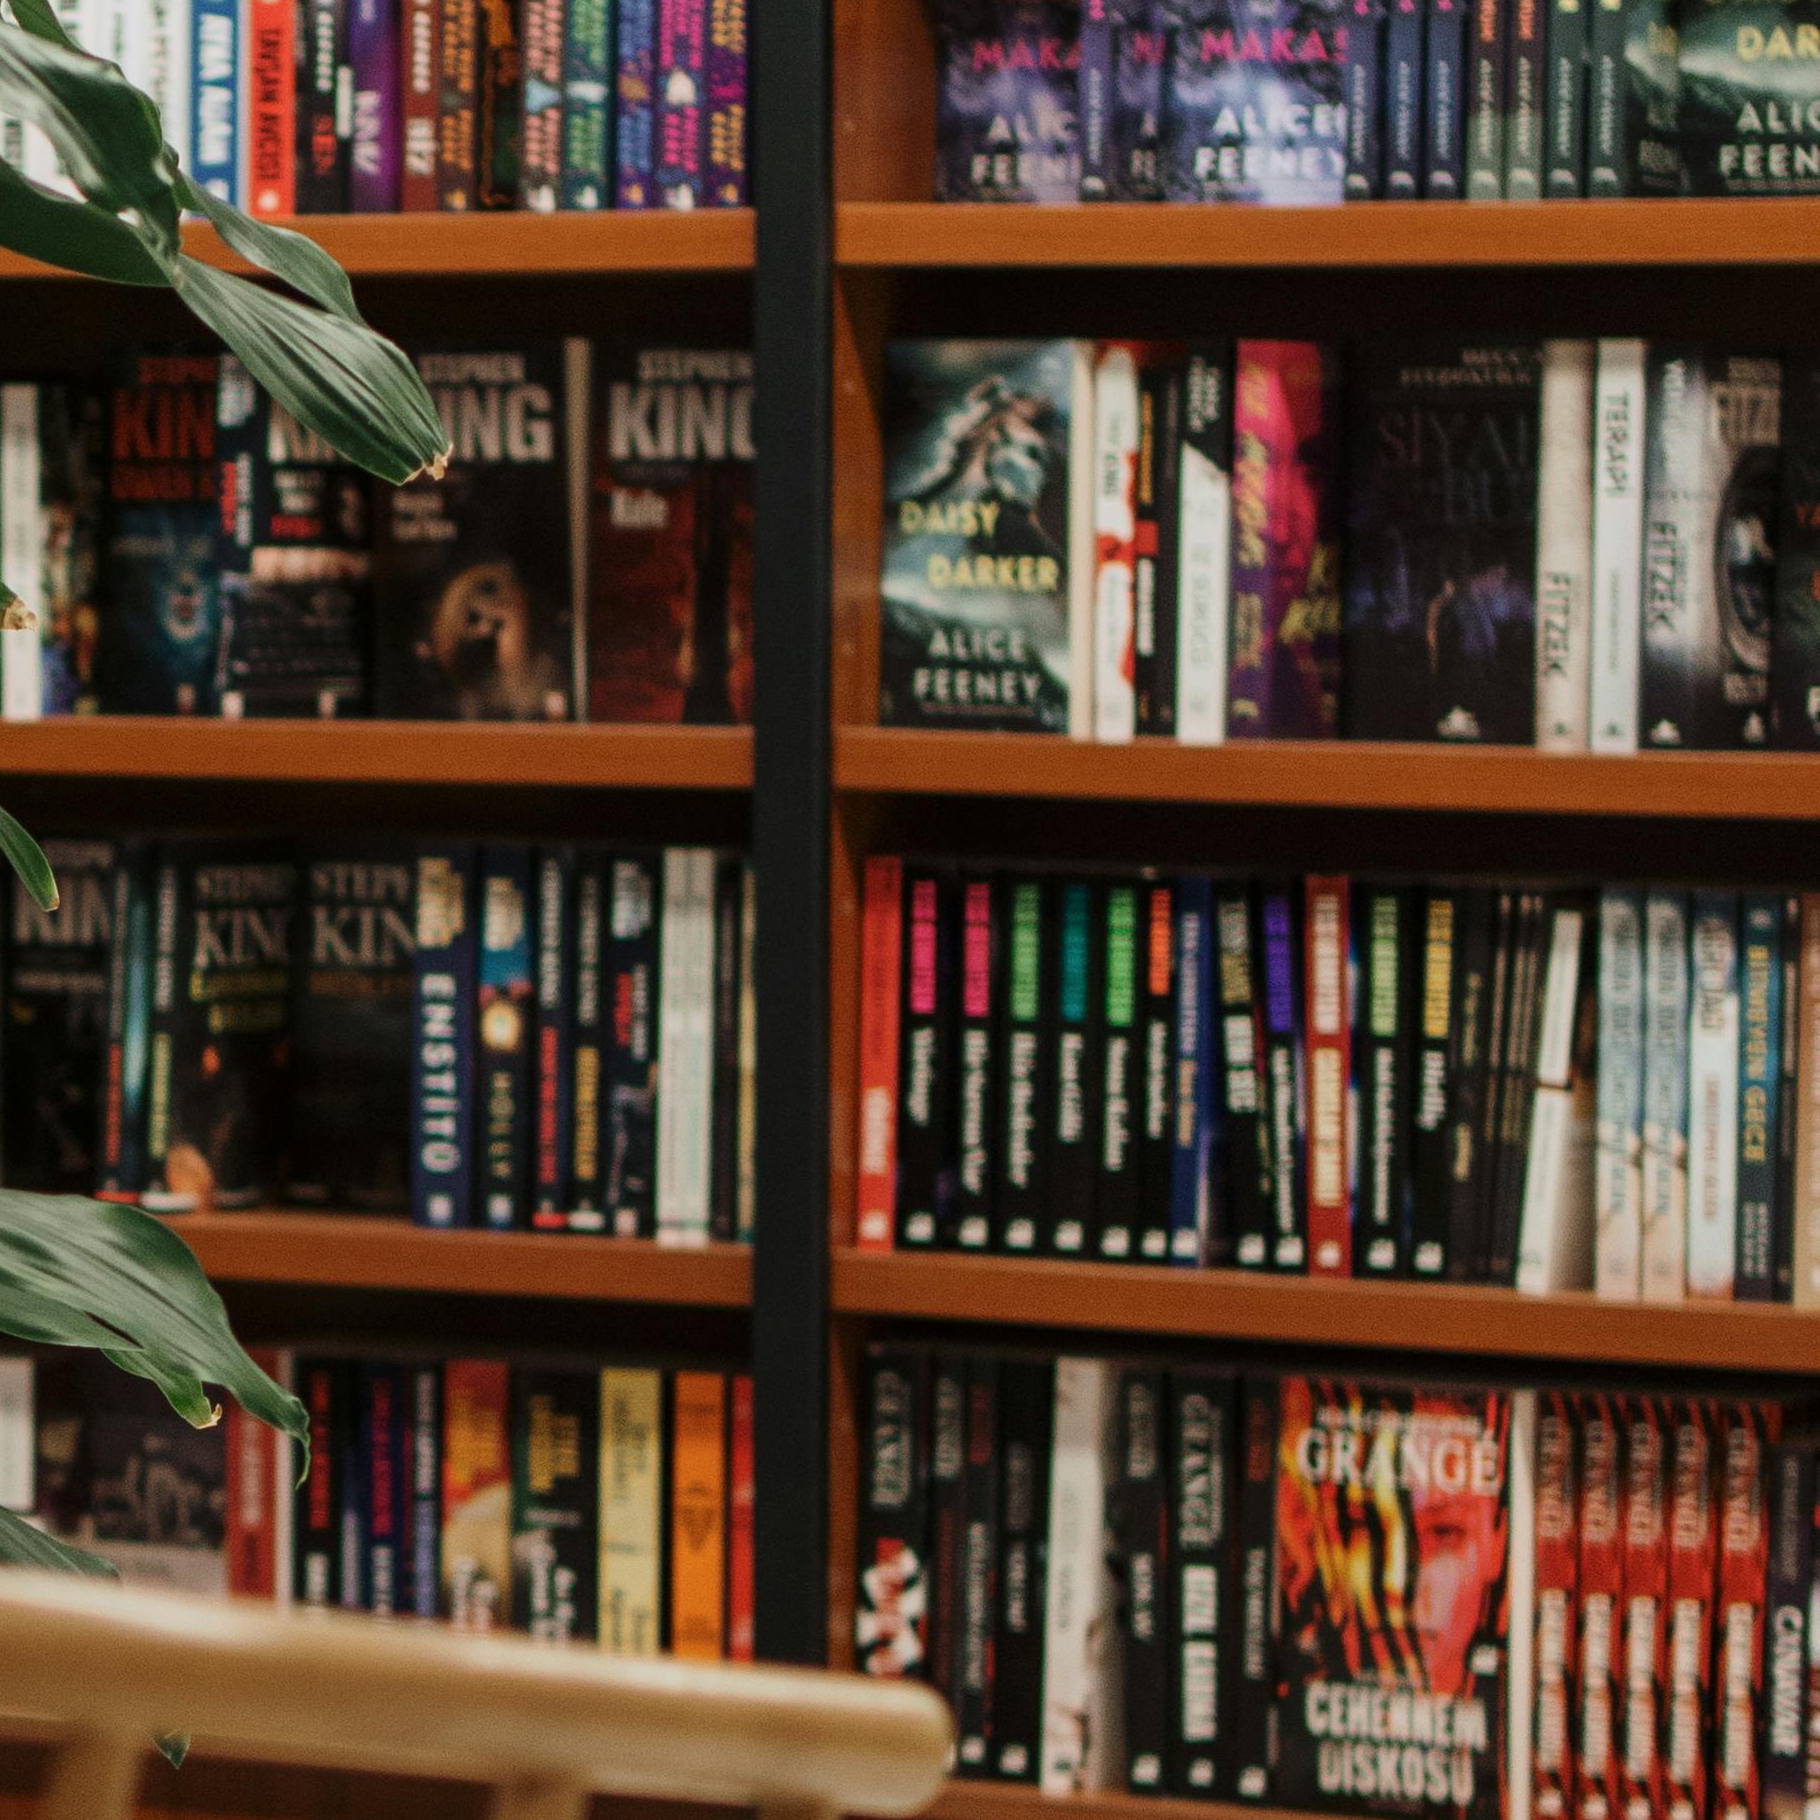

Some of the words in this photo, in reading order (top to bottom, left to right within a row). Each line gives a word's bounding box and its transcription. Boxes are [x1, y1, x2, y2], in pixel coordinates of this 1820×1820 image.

[972, 36, 1082, 71] MAKA
[1736, 24, 1820, 61] DAR
[1736, 101, 1820, 134] ALIC
[1719, 141, 1820, 178] FEEN
[111, 386, 216, 459] KIN
[194, 910, 288, 968] KIN
[311, 905, 420, 966] KIN
